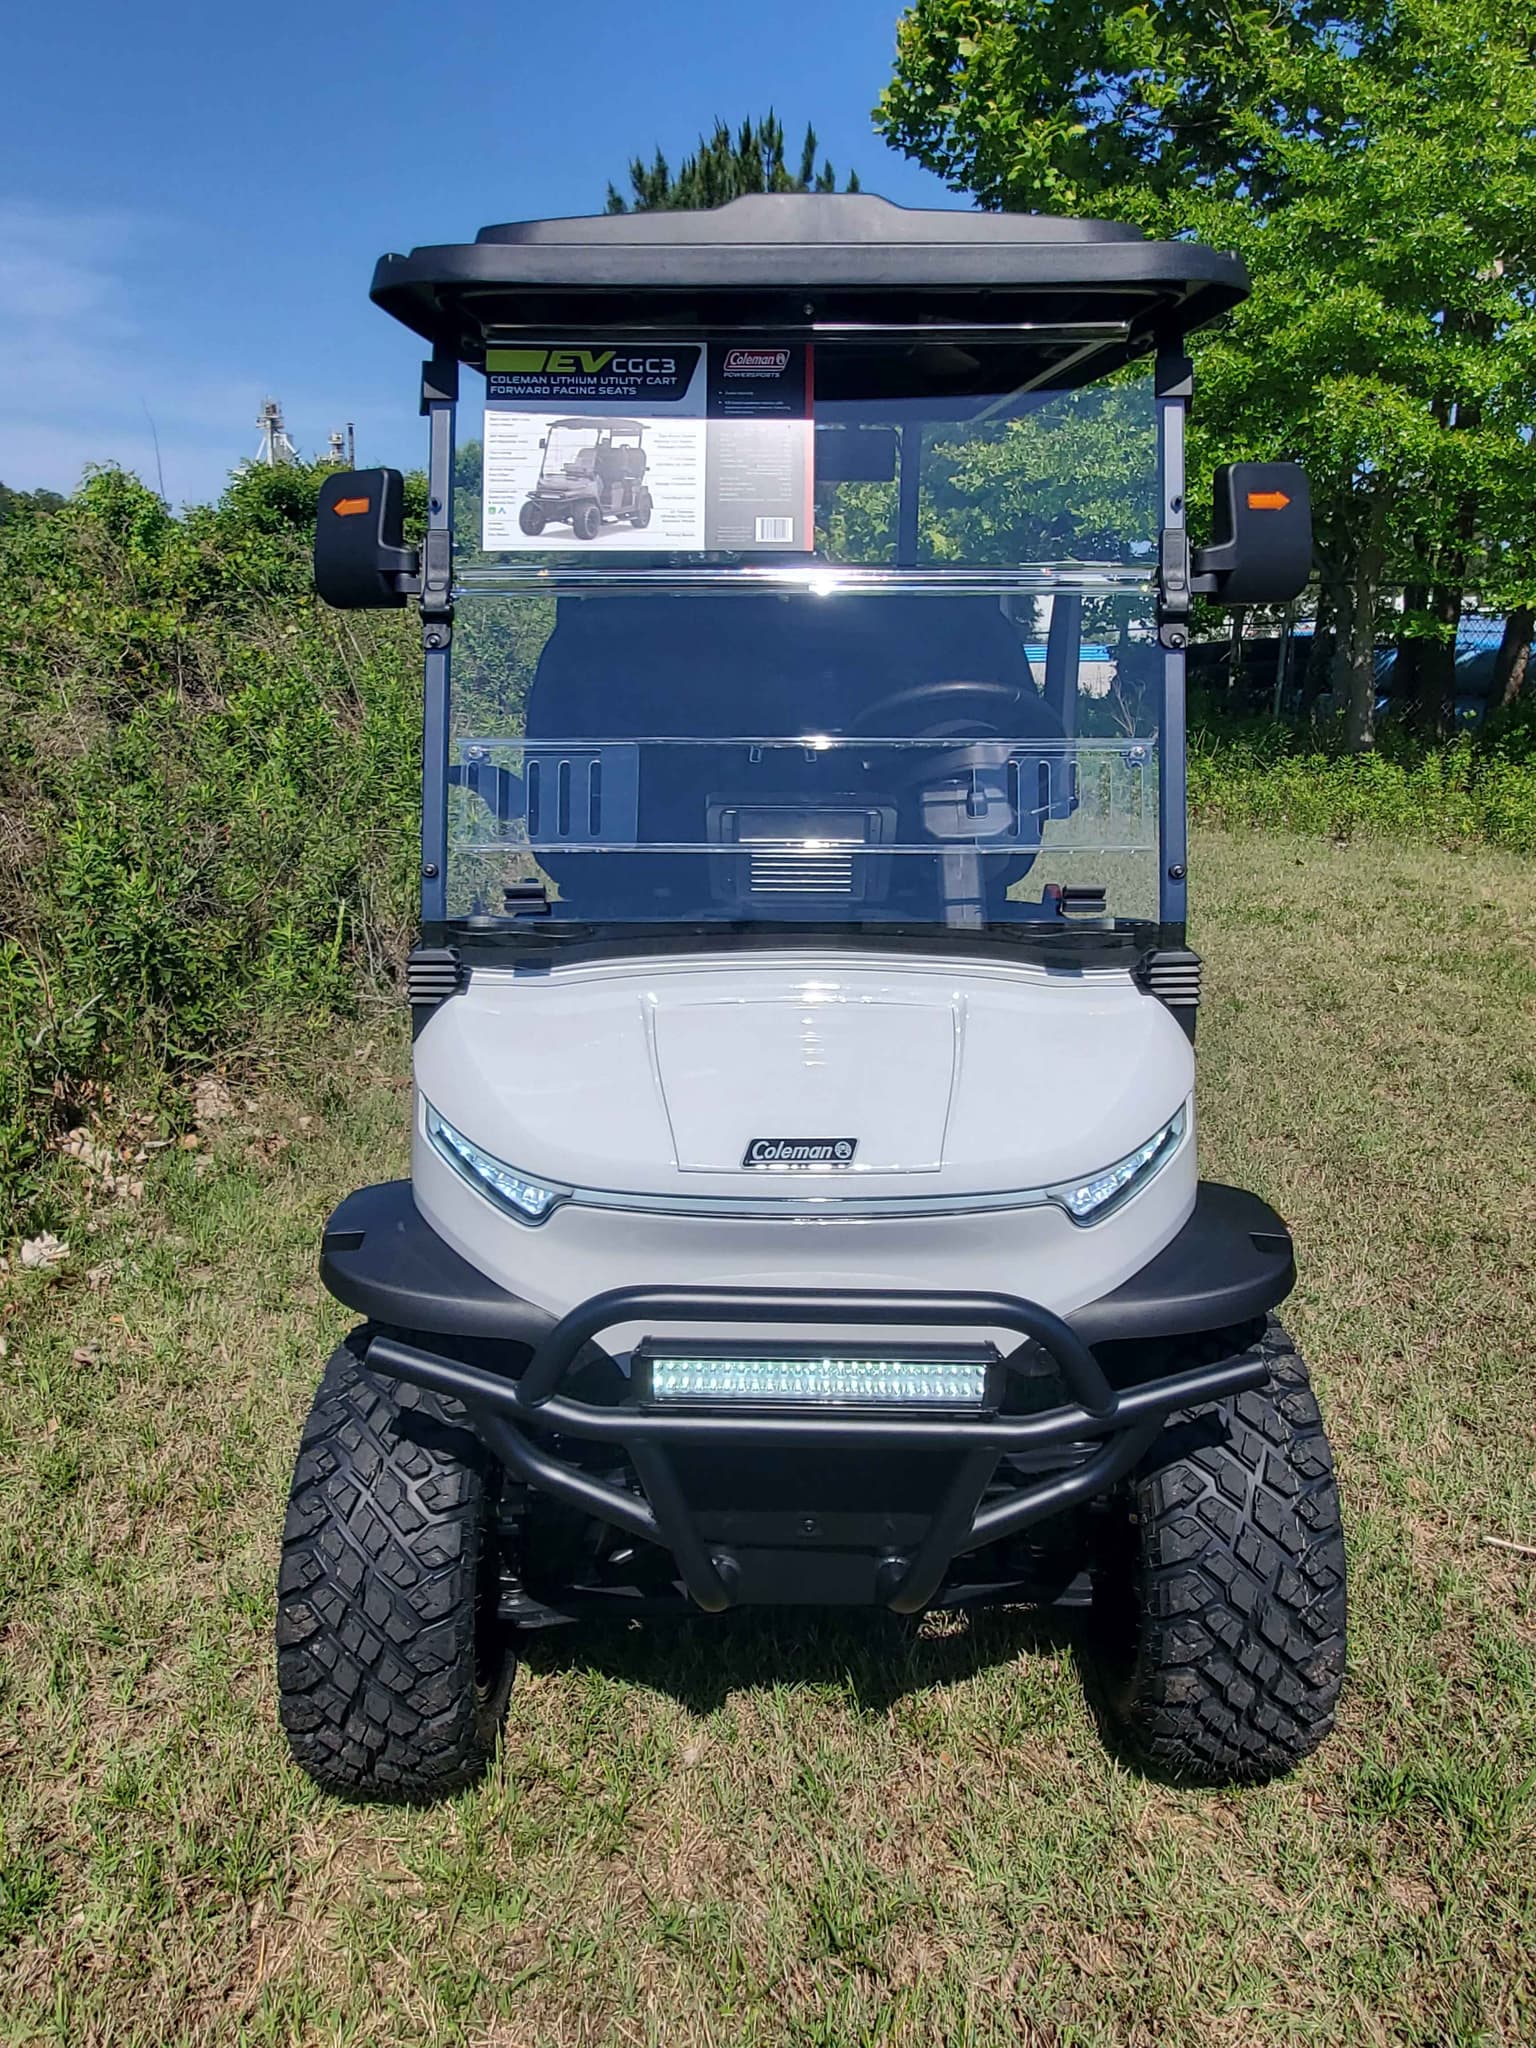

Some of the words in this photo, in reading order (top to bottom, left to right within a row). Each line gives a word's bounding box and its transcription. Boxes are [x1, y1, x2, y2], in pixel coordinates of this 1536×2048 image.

[546, 350, 617, 373] EV
[612, 358, 677, 374] CGC3
[730, 352, 775, 366] Coleman
[490, 376, 548, 385] COLEMAN
[550, 376, 598, 386] LITHIUM
[600, 377, 644, 386] UTILITY
[646, 377, 678, 386] CART
[490, 386, 551, 396] FORWARD
[553, 387, 596, 396] FACING
[598, 387, 637, 396] SEATS
[751, 1141, 834, 1160] Coleman
